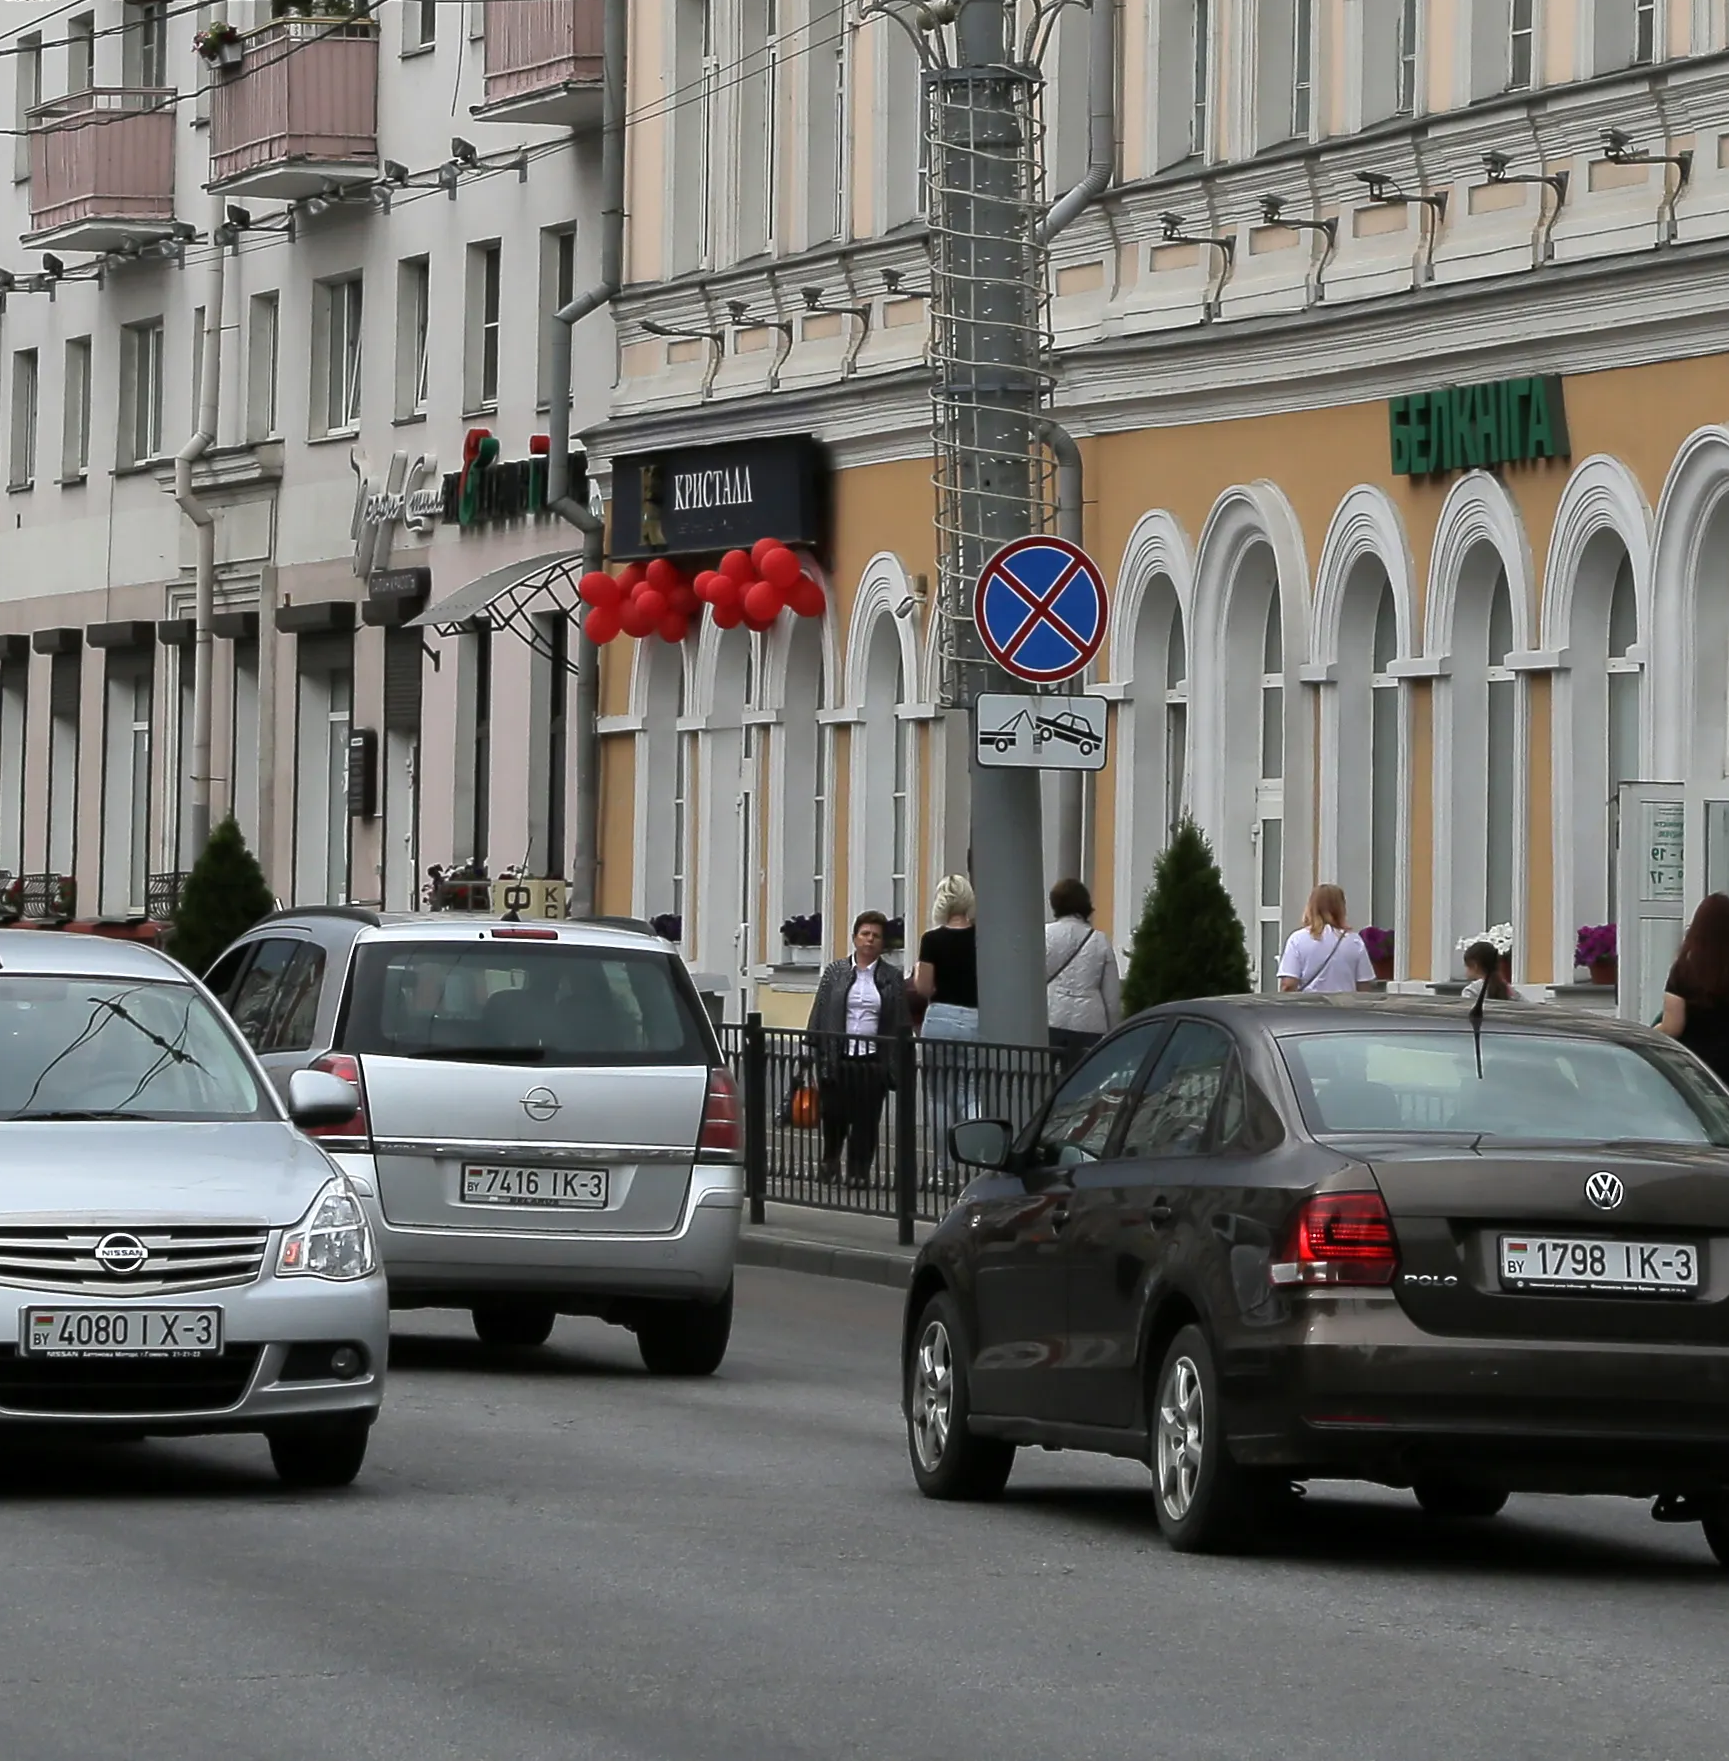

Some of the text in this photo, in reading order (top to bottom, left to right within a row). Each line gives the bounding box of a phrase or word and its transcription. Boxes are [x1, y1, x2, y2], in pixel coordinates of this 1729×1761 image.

[673, 464, 753, 511] КРИСТАЛЛ
[467, 1169, 602, 1198] BY 7416 IK-3
[101, 1249, 144, 1257] NISSAN
[1507, 1242, 1692, 1281] BY 1798 IK-3
[1404, 1274, 1458, 1287] POLO
[33, 1332, 50, 1346] BY
[58, 1314, 128, 1345] 4080
[47, 1350, 79, 1358] NISSAN
